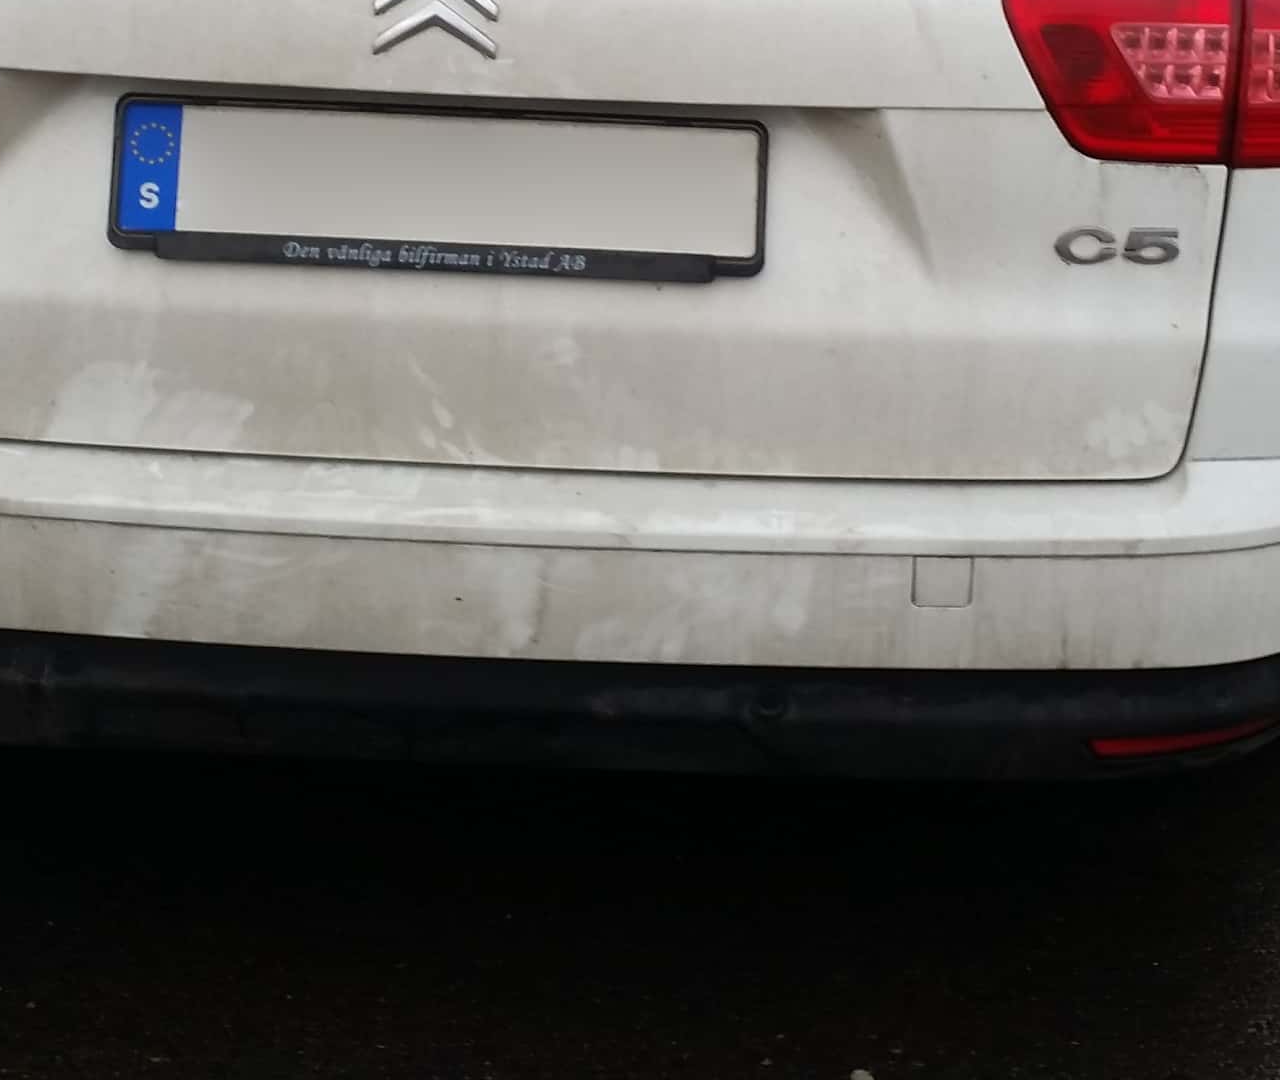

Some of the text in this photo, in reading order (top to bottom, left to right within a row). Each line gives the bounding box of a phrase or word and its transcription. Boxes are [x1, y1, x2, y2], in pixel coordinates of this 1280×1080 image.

[139, 181, 160, 209] S
[283, 241, 587, 271] Den vänliga bilfirman i Ystad AB
[1053, 225, 1180, 266] C5
